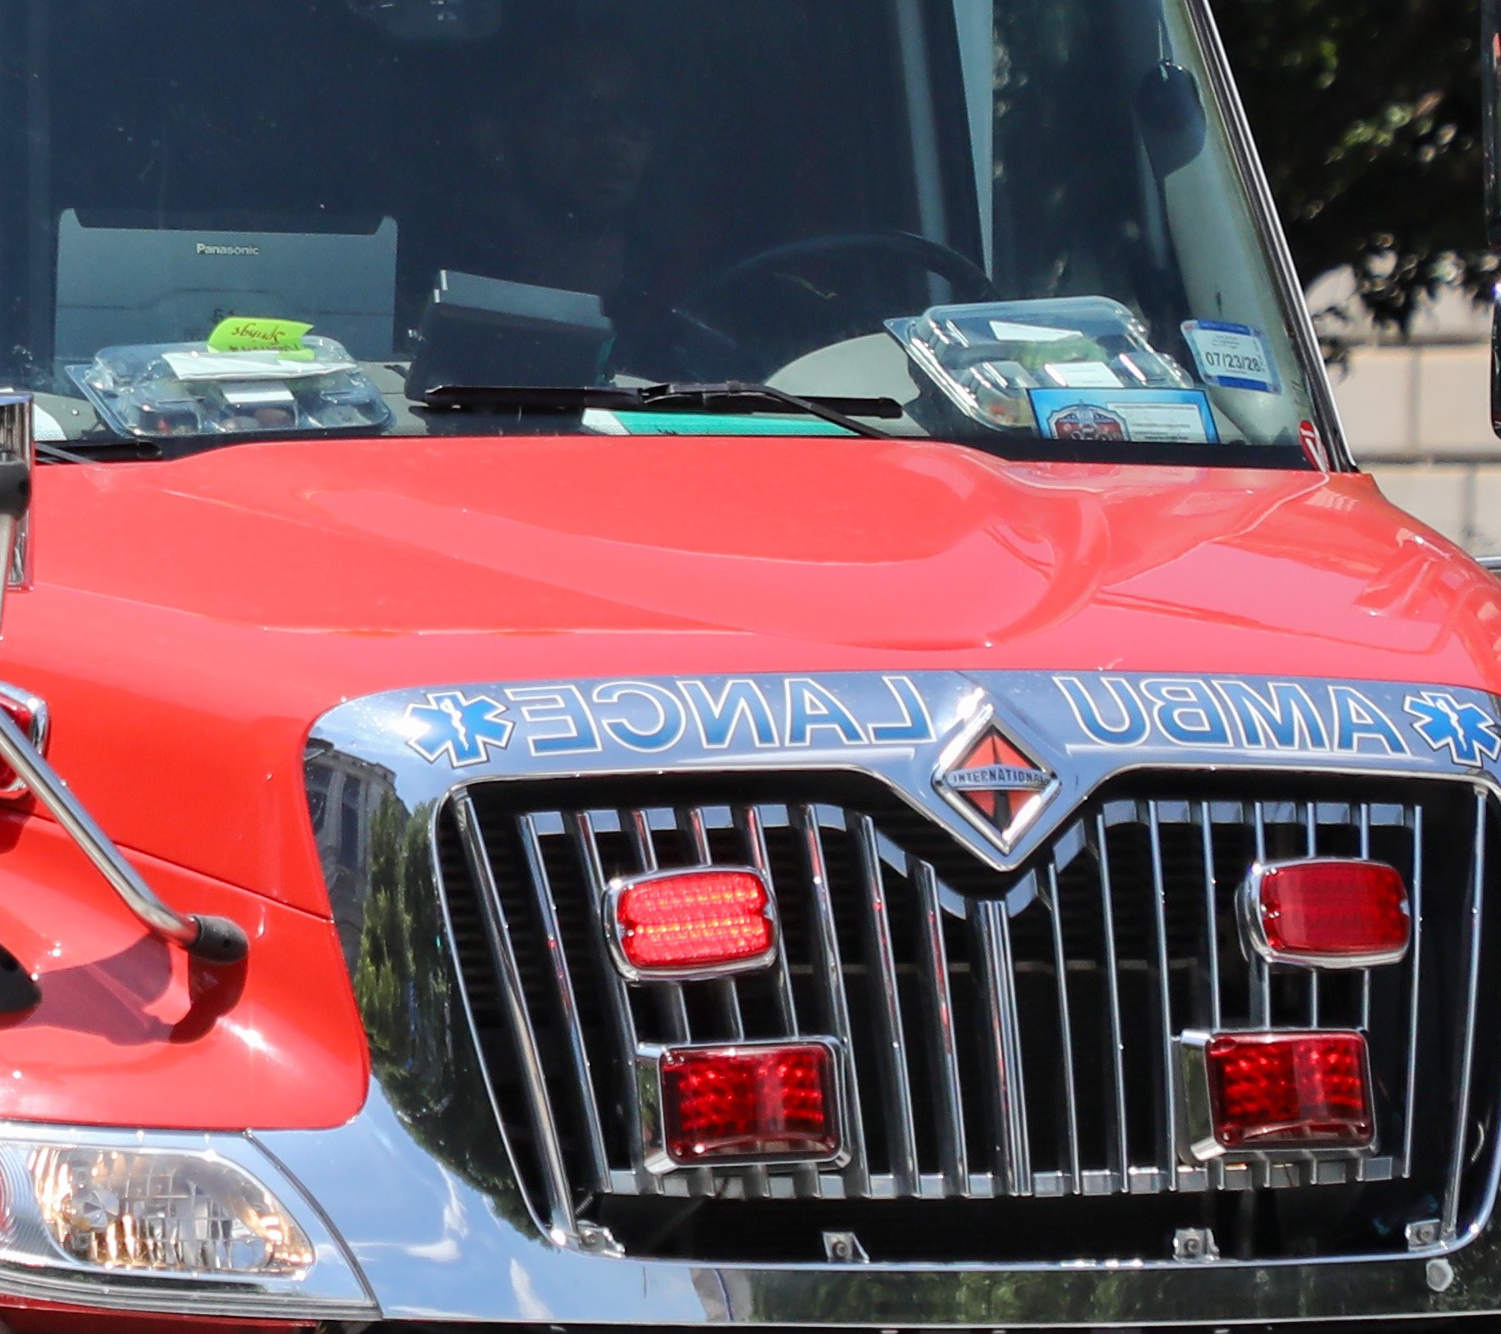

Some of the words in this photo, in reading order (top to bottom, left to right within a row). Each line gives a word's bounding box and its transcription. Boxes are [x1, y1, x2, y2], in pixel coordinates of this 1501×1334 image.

[196, 242, 260, 255] Panasonic
[1205, 352, 1261, 372] 07/23/28
[953, 766, 1049, 784] INTERNATIONAL
